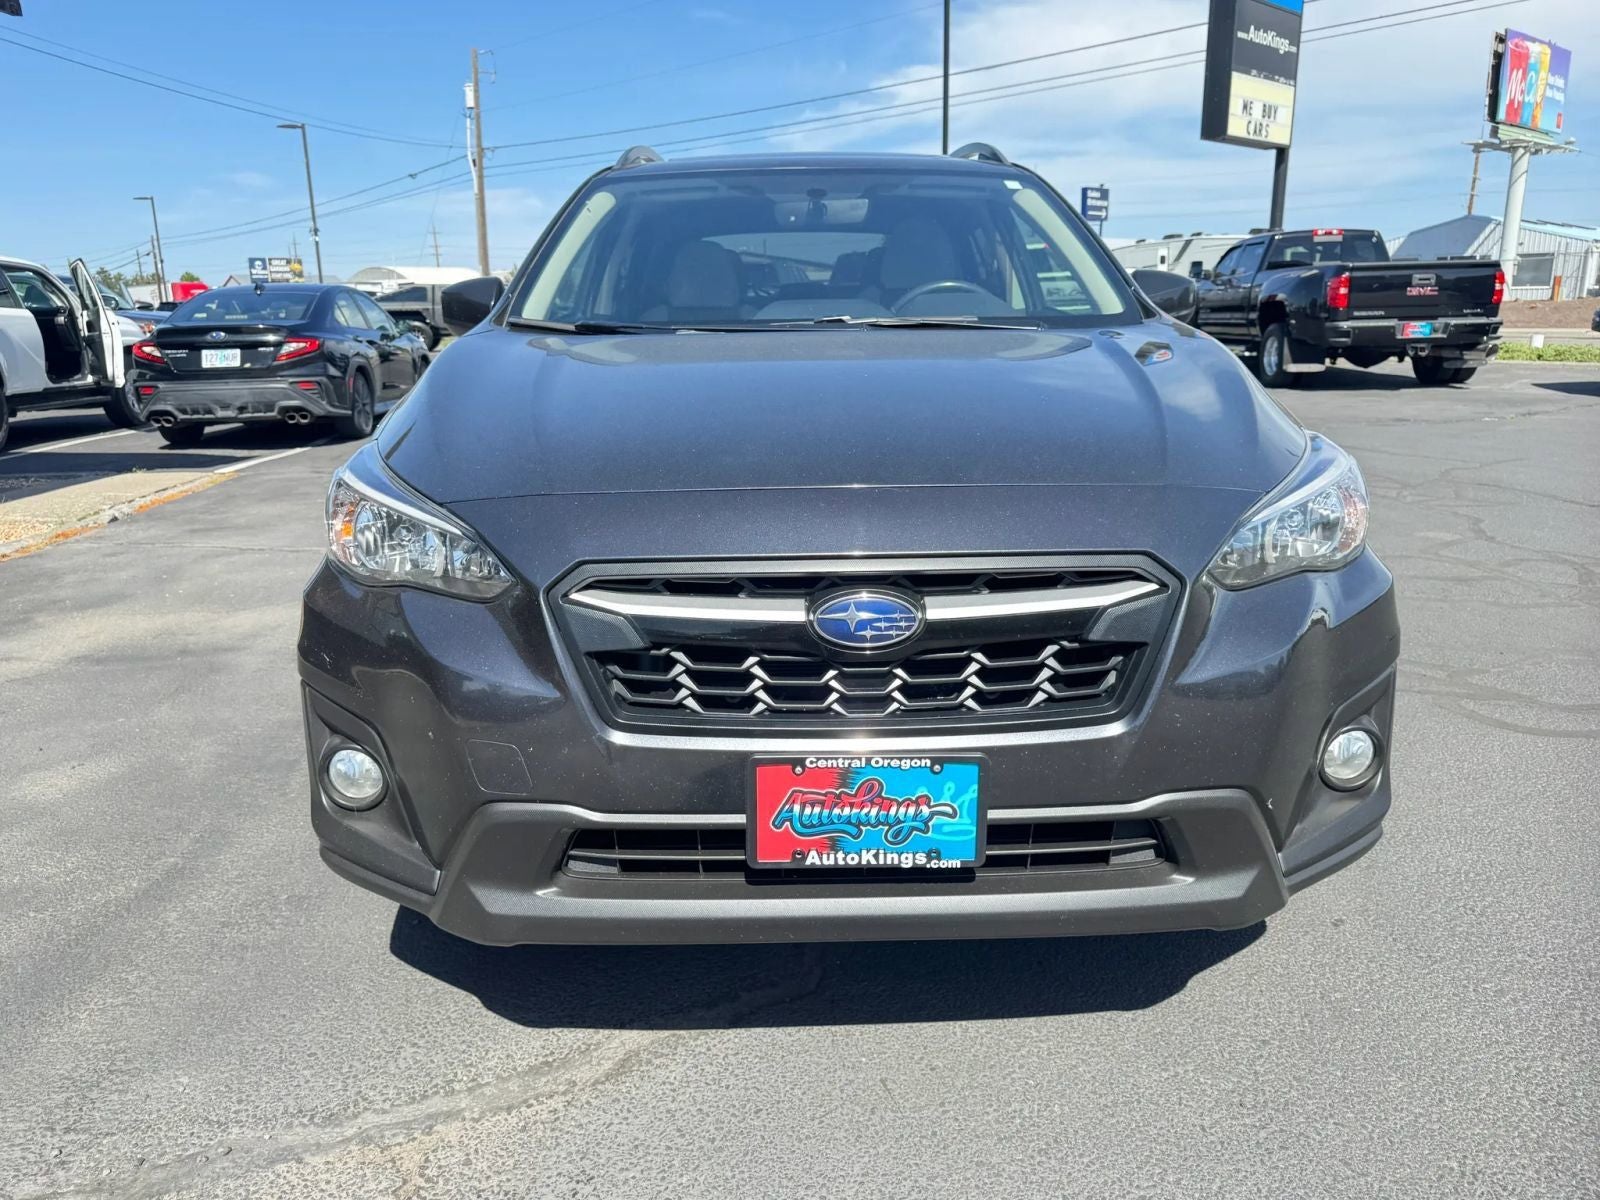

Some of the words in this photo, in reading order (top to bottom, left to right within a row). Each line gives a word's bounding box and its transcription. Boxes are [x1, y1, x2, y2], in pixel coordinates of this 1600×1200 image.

[1262, 103, 1279, 120] BUY
[1246, 120, 1270, 138] CARS
[805, 757, 866, 768] Central
[870, 757, 931, 770] Oregon
[805, 849, 961, 869] AutoKings.com
